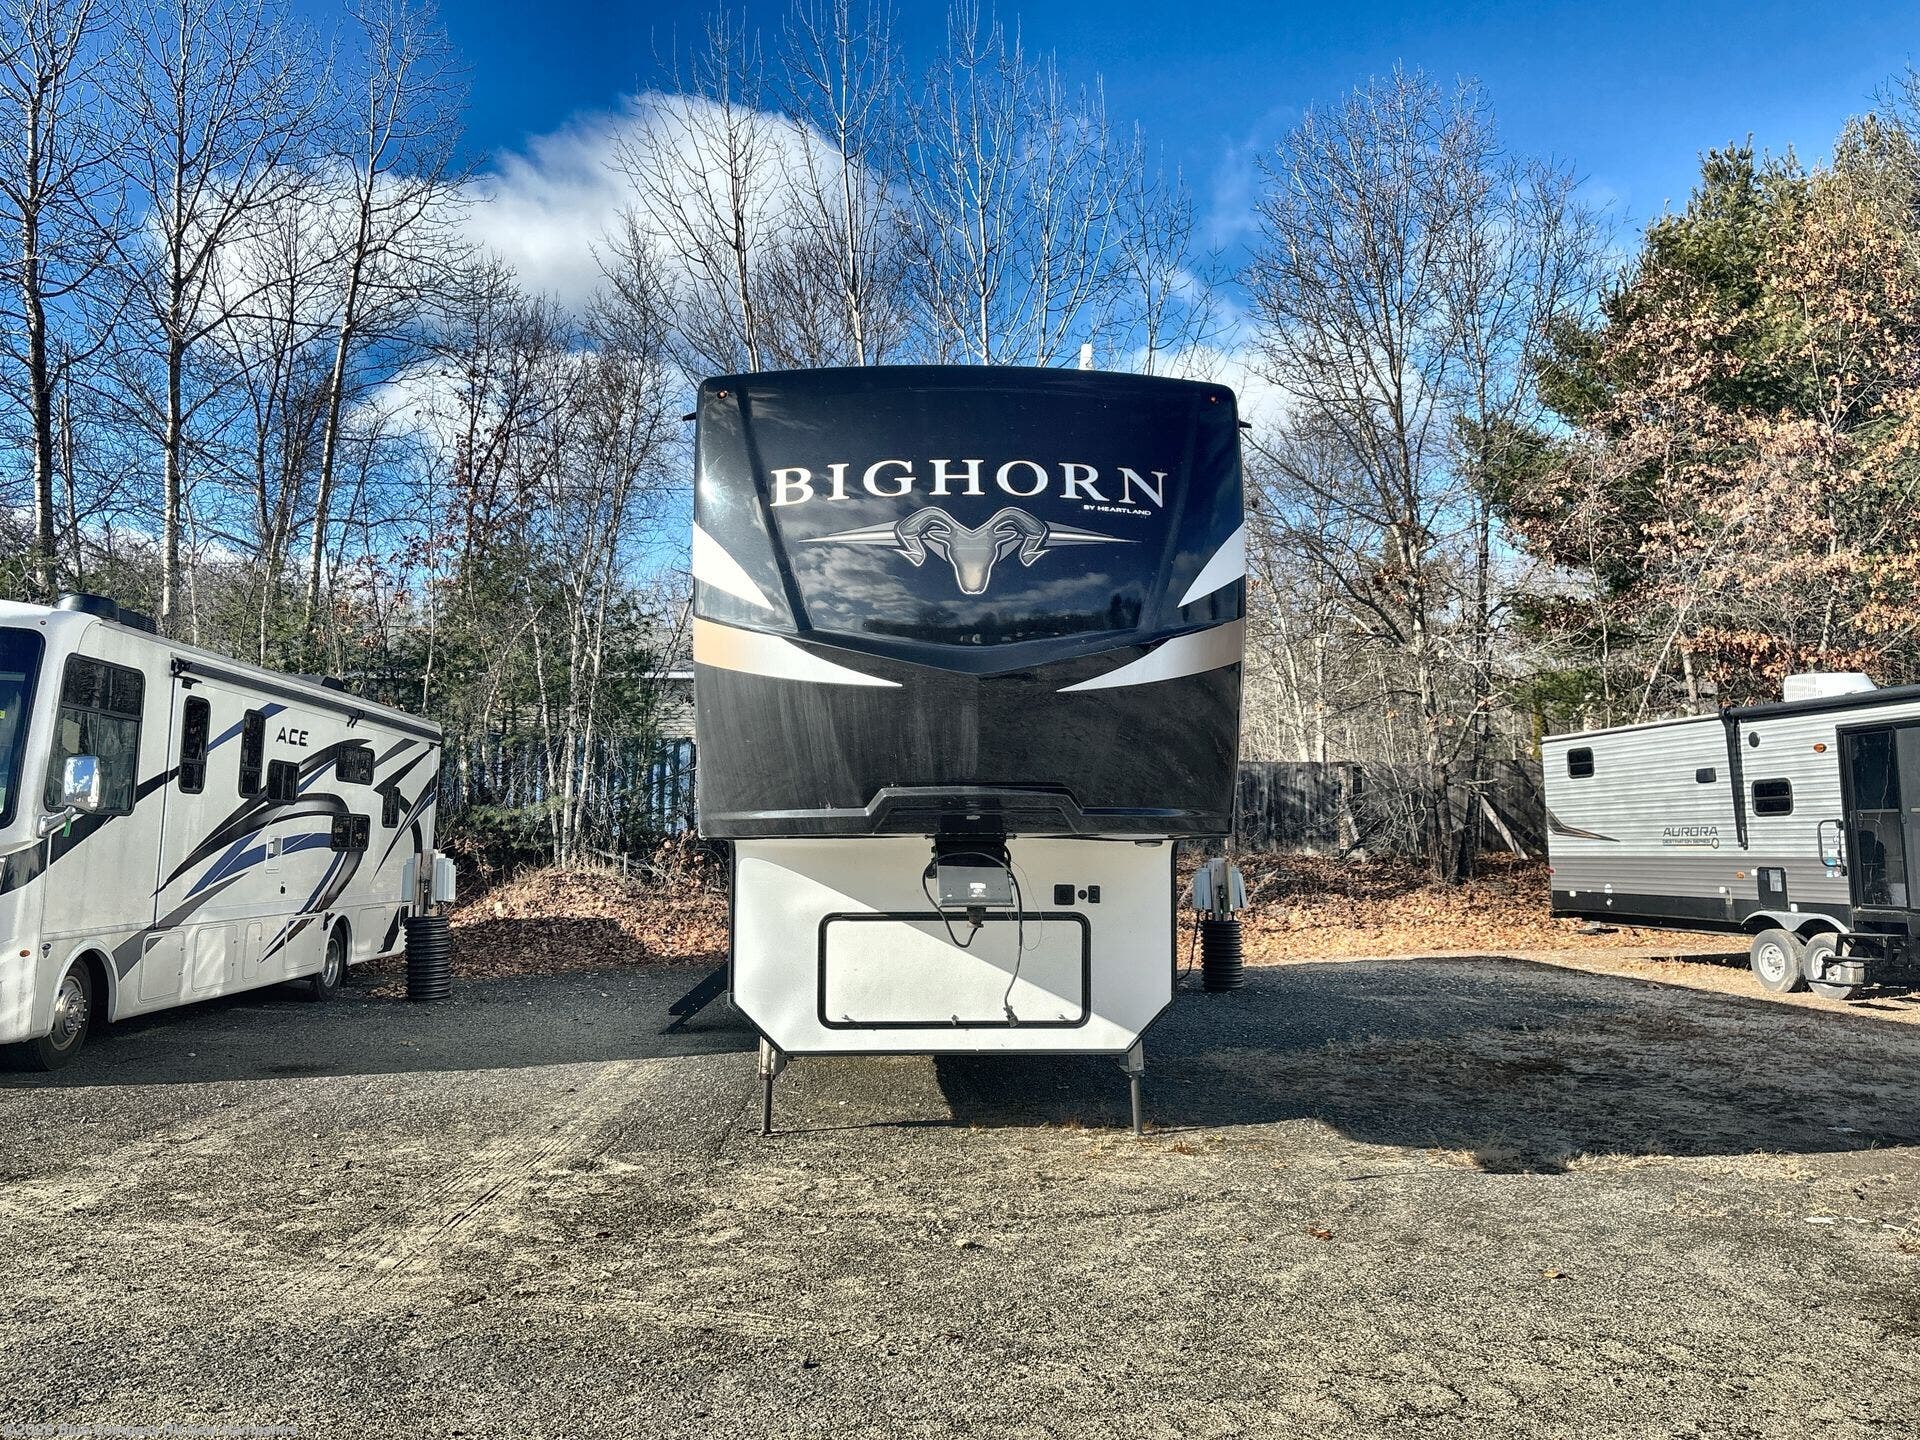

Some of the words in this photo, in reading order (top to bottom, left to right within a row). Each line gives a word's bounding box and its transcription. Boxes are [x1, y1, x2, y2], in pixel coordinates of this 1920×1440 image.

[770, 459, 1168, 508] BIGHORN
[1097, 505, 1152, 516] HEARTLAND
[1663, 826, 1718, 837] AURORA
